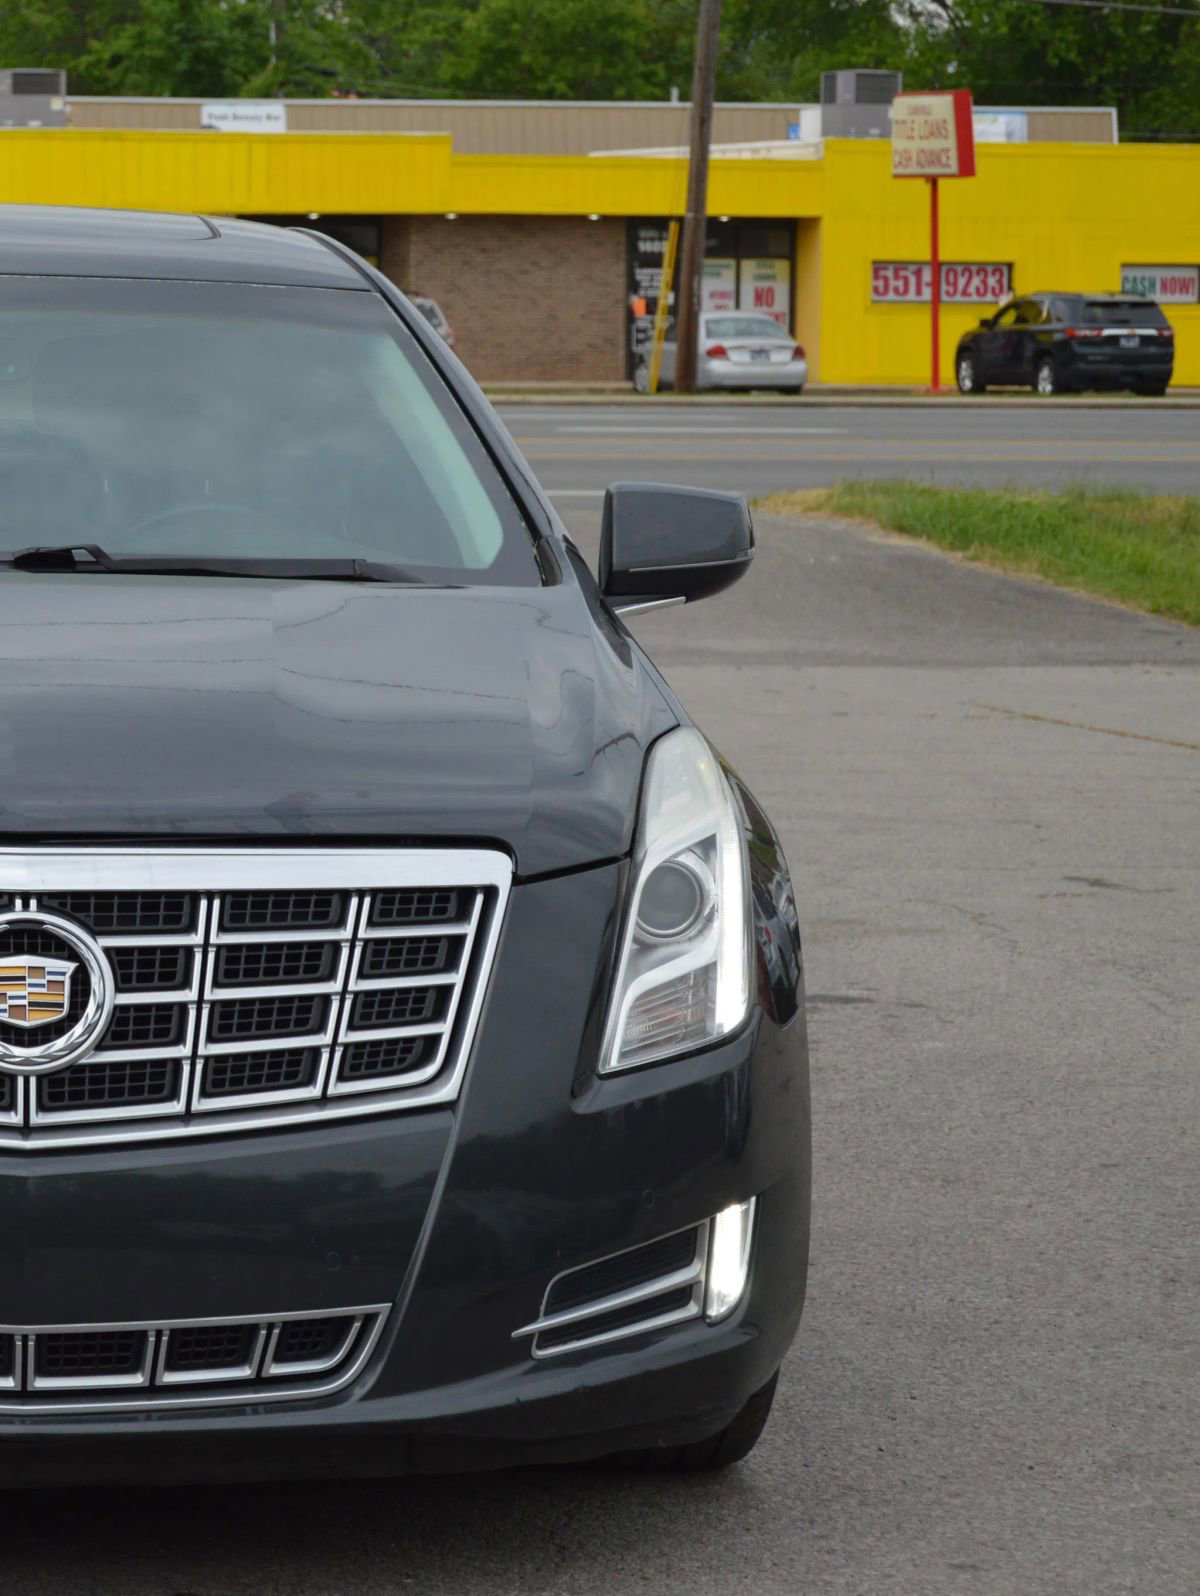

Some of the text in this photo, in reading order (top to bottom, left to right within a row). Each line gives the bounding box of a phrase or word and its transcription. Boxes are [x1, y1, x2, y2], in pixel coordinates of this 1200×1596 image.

[919, 118, 949, 139] LOANS
[915, 148, 952, 168] ADVANCE
[1122, 275, 1196, 296] CASH NOW!
[754, 286, 775, 308] NO
